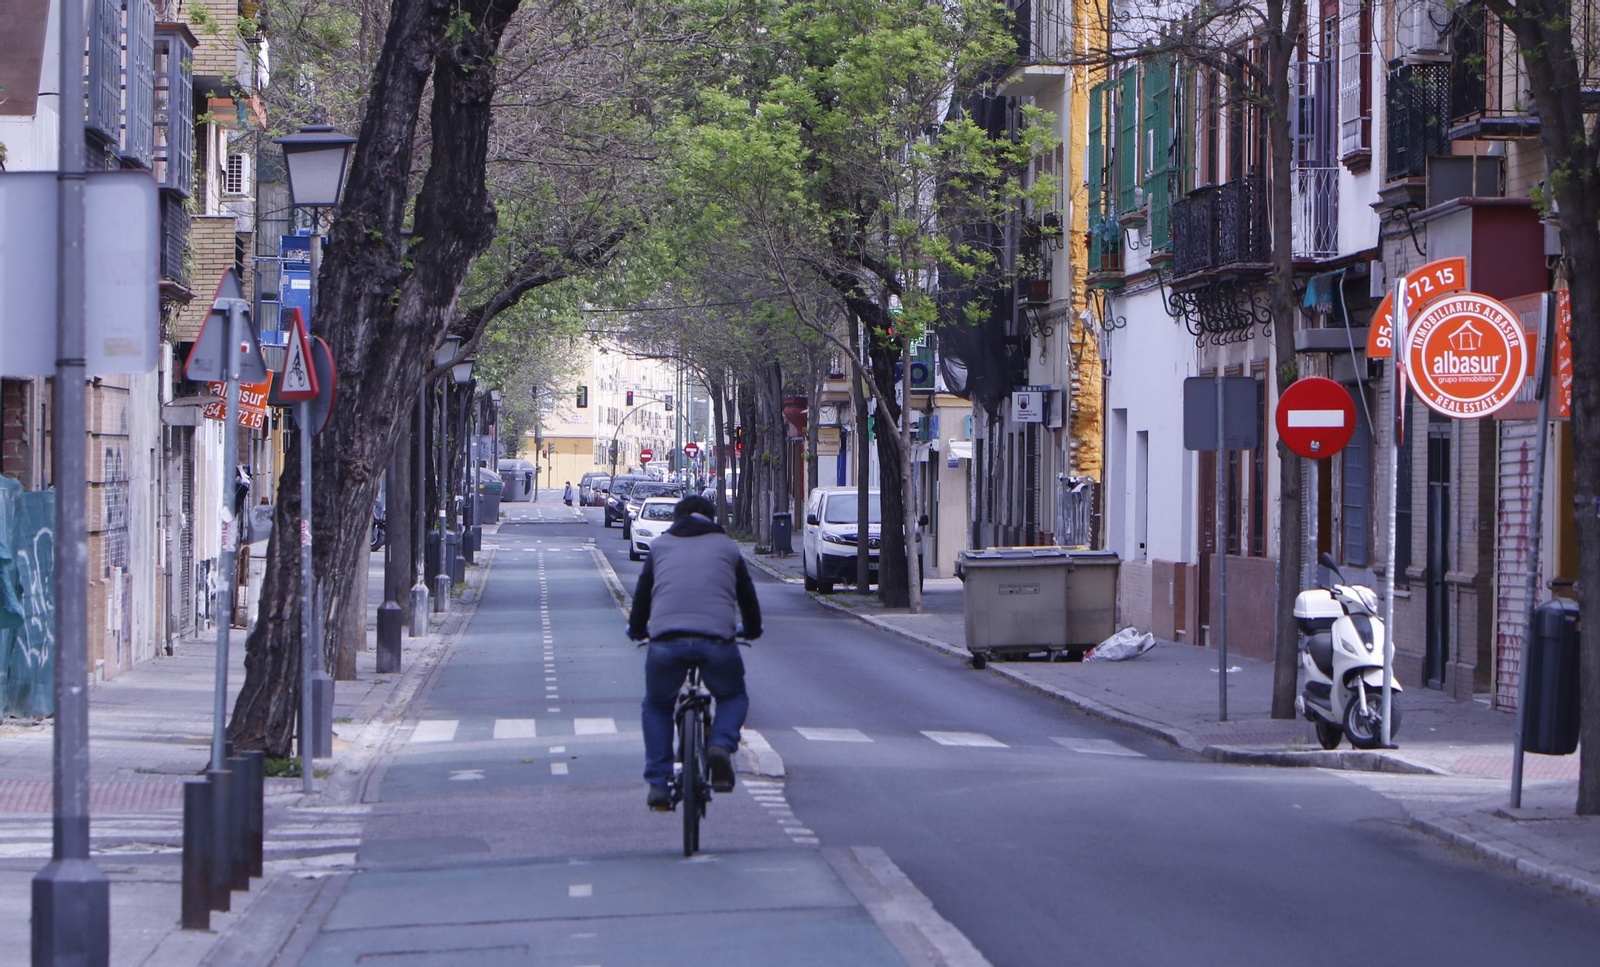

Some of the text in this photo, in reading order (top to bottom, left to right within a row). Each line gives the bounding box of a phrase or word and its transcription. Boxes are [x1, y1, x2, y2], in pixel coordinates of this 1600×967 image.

[1409, 276, 1434, 298] 72
[1435, 267, 1454, 285] 15
[1412, 302, 1519, 349] INMOBILIARIAS ALBASUR
[1433, 350, 1499, 374] albasur
[1438, 375, 1495, 385] grupo inmobiliario
[211, 382, 265, 406] alsur
[1435, 393, 1500, 413] REAL ESTATE
[237, 410, 249, 425] 72
[250, 413, 263, 427] 15
